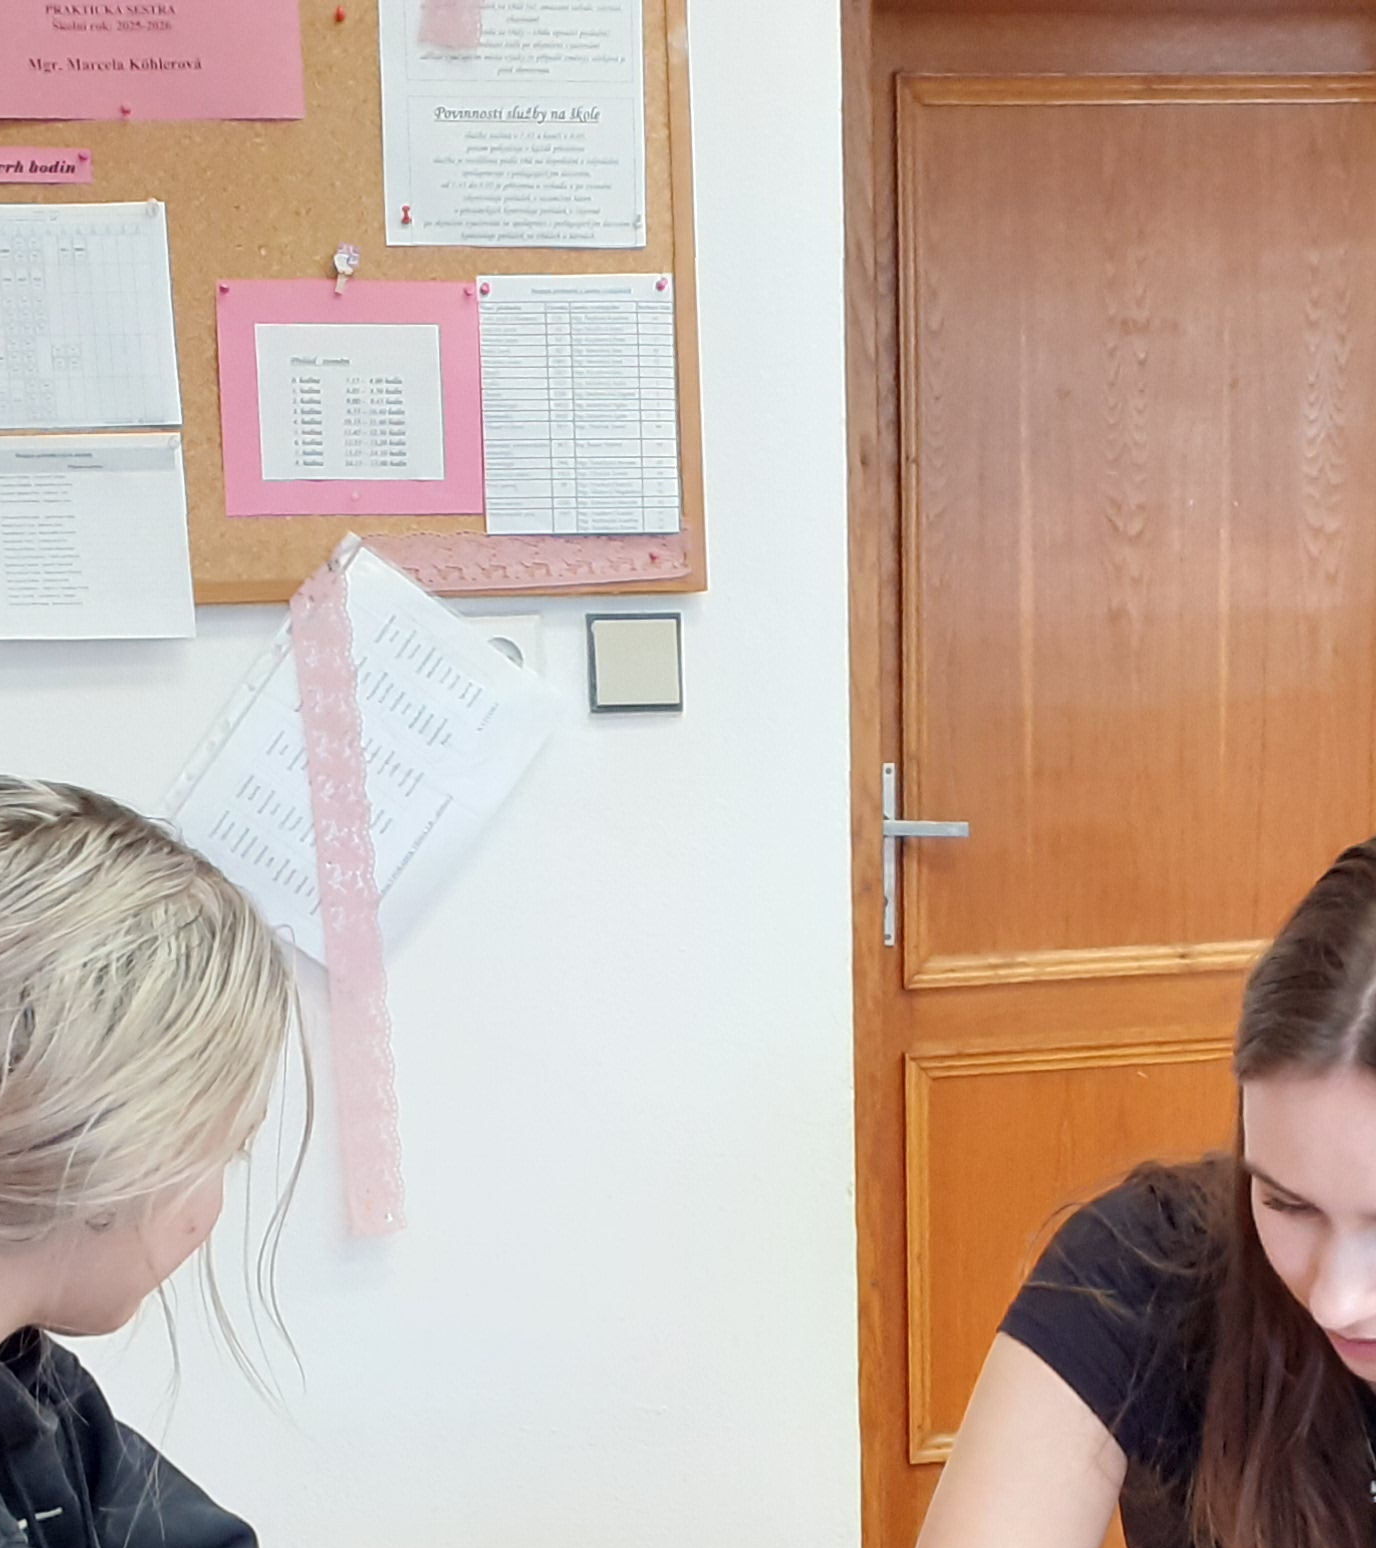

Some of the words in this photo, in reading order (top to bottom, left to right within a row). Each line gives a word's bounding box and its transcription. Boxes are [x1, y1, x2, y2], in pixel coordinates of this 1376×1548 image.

[126, 4, 175, 15] SESTRA
[28, 58, 63, 73] Mgr.
[67, 58, 123, 71] Marcela
[129, 56, 202, 71] Köhlerová
[433, 105, 504, 121] Povinnosti
[506, 105, 546, 124] služby
[550, 108, 566, 121] na
[569, 105, 601, 123] škole
[28, 160, 76, 174] hodin
